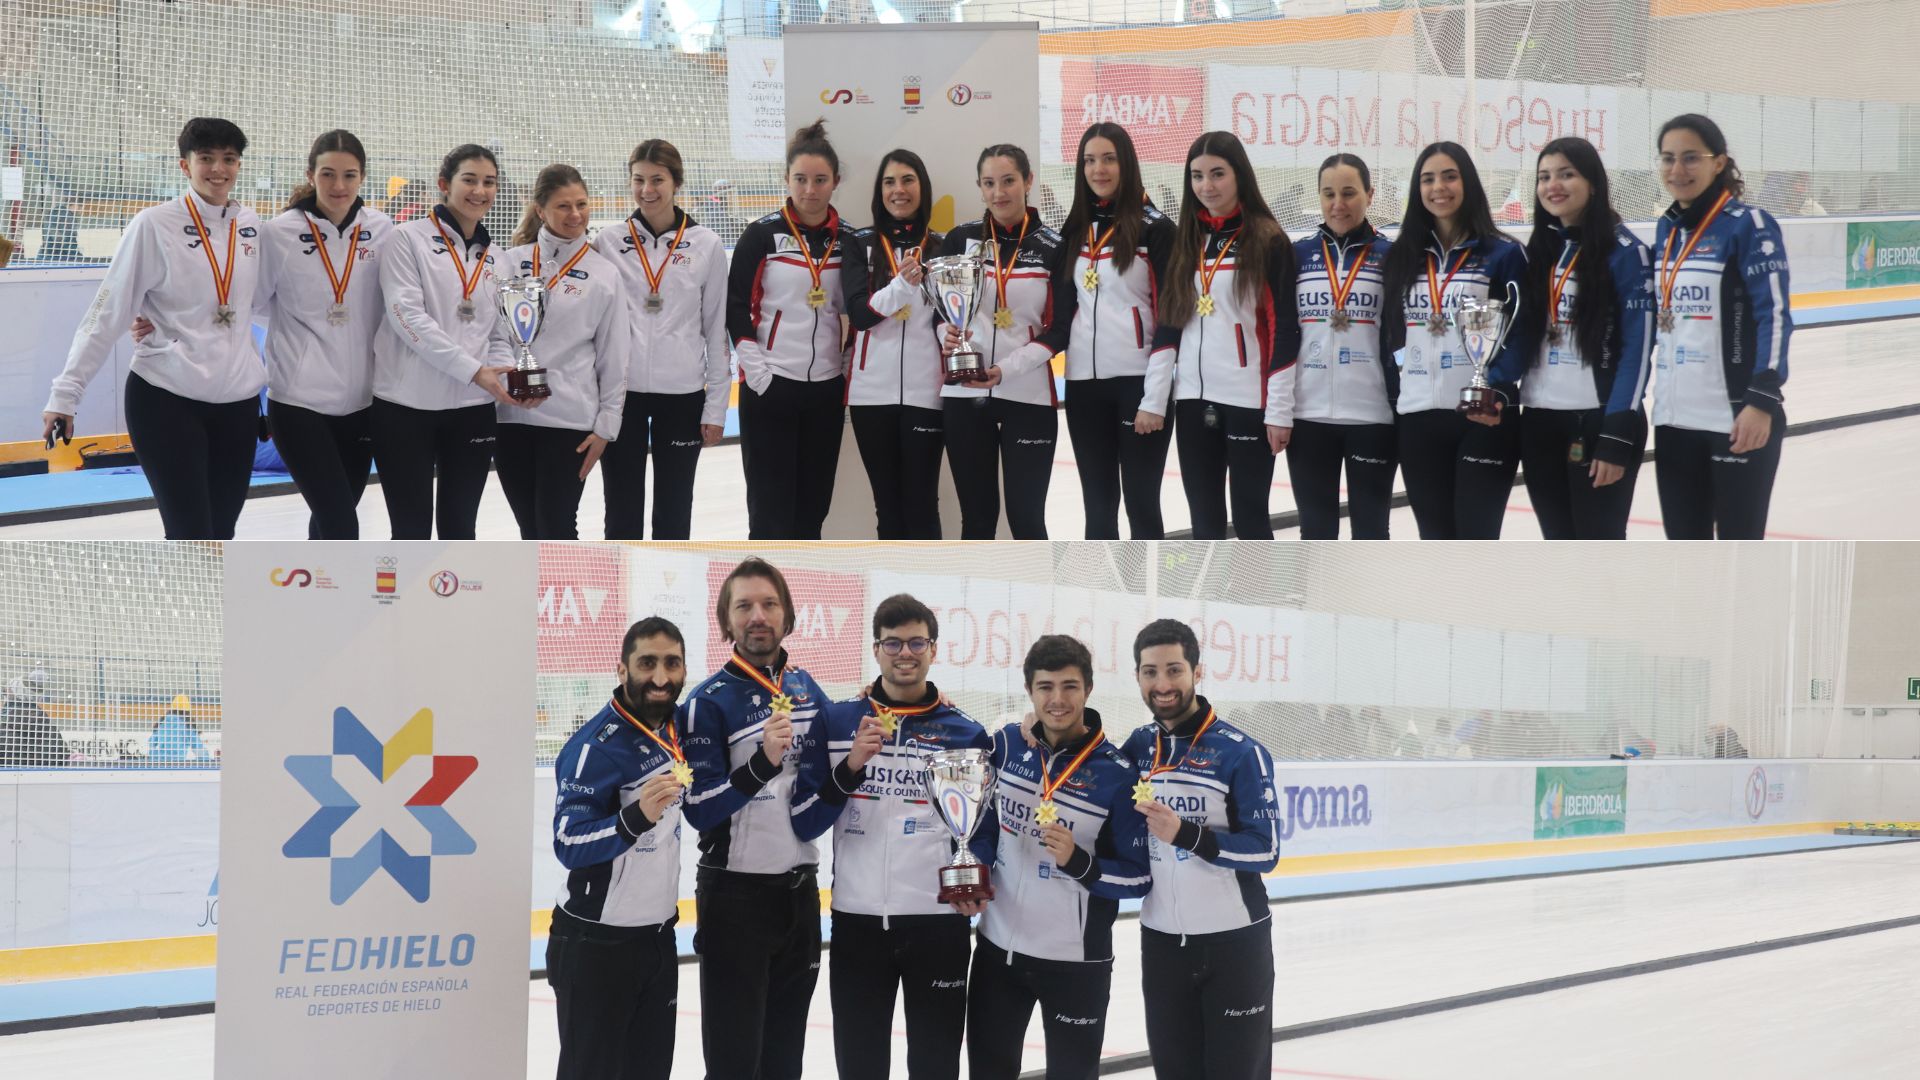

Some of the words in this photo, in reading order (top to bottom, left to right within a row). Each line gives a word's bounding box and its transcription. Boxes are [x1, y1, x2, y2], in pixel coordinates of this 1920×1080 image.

[1298, 291, 1380, 308] EUSADI
[746, 708, 771, 722] AITON
[1006, 760, 1035, 778] AITONA
[1564, 794, 1622, 817] IBERDROLA
[279, 933, 475, 974] FEDHIELO
[275, 986, 309, 999] REAL
[313, 980, 398, 997] FEDERACIÓN
[401, 977, 468, 993] ESPAÑOLA
[307, 1000, 378, 1016] DEPORTES
[382, 1000, 400, 1012] DE
[403, 998, 441, 1011] HIELO
[1225, 1005, 1266, 1017] Hardline
[1056, 1013, 1098, 1025] Hardline
